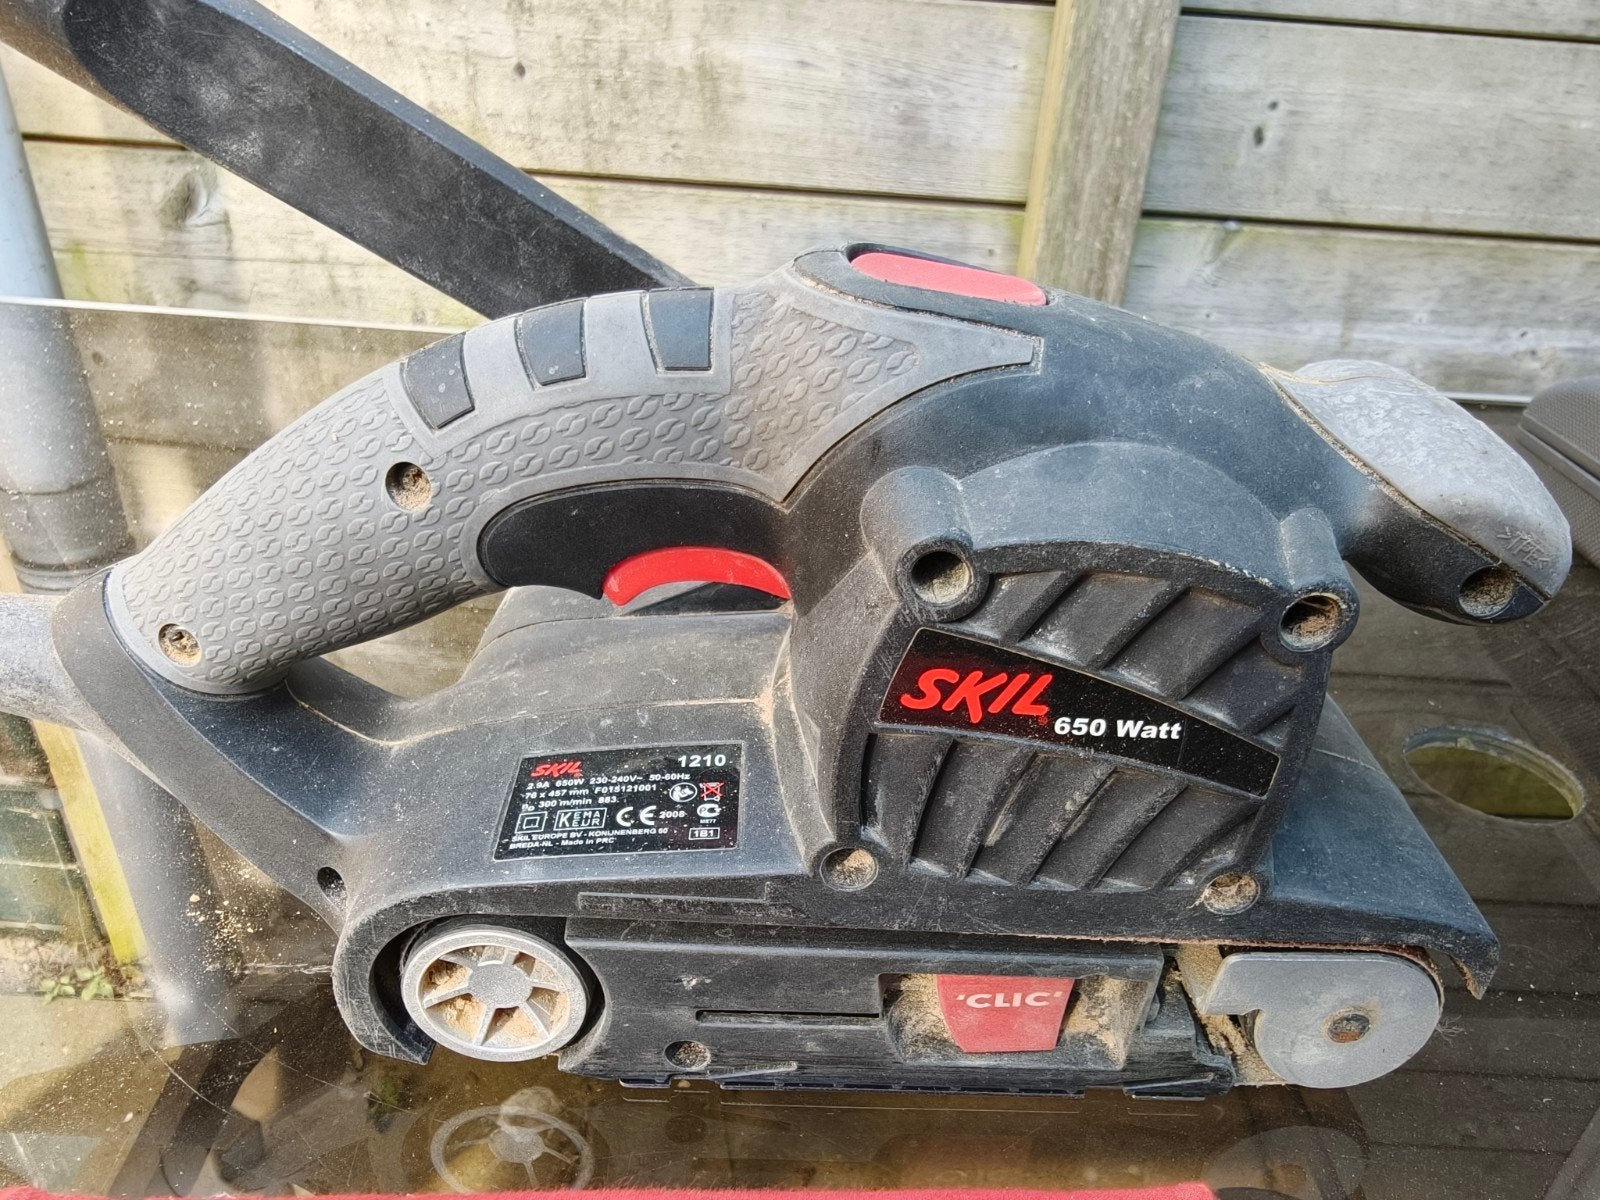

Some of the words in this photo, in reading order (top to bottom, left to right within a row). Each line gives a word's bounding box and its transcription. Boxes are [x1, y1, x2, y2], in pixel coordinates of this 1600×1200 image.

[900, 668, 1053, 723] SKIL
[1054, 717, 1106, 737] 650
[1116, 719, 1182, 740] Watt
[678, 754, 726, 768] 1210
[530, 761, 582, 777] SKIL
[527, 781, 550, 790] 2.9A
[555, 778, 585, 787] 650W
[649, 773, 691, 781] 50-60Hz
[525, 791, 537, 799] 76
[548, 789, 567, 797] 457
[594, 784, 657, 794] F015121001
[538, 800, 557, 808] 300
[559, 798, 592, 807] m/min
[616, 805, 657, 827] CE
[659, 811, 686, 819] 2008
[512, 834, 531, 842] SKIL
[532, 832, 568, 840] EUROPE
[693, 829, 714, 838] 1B1
[509, 840, 554, 850] BREDA-NL
[561, 838, 584, 846] Made
